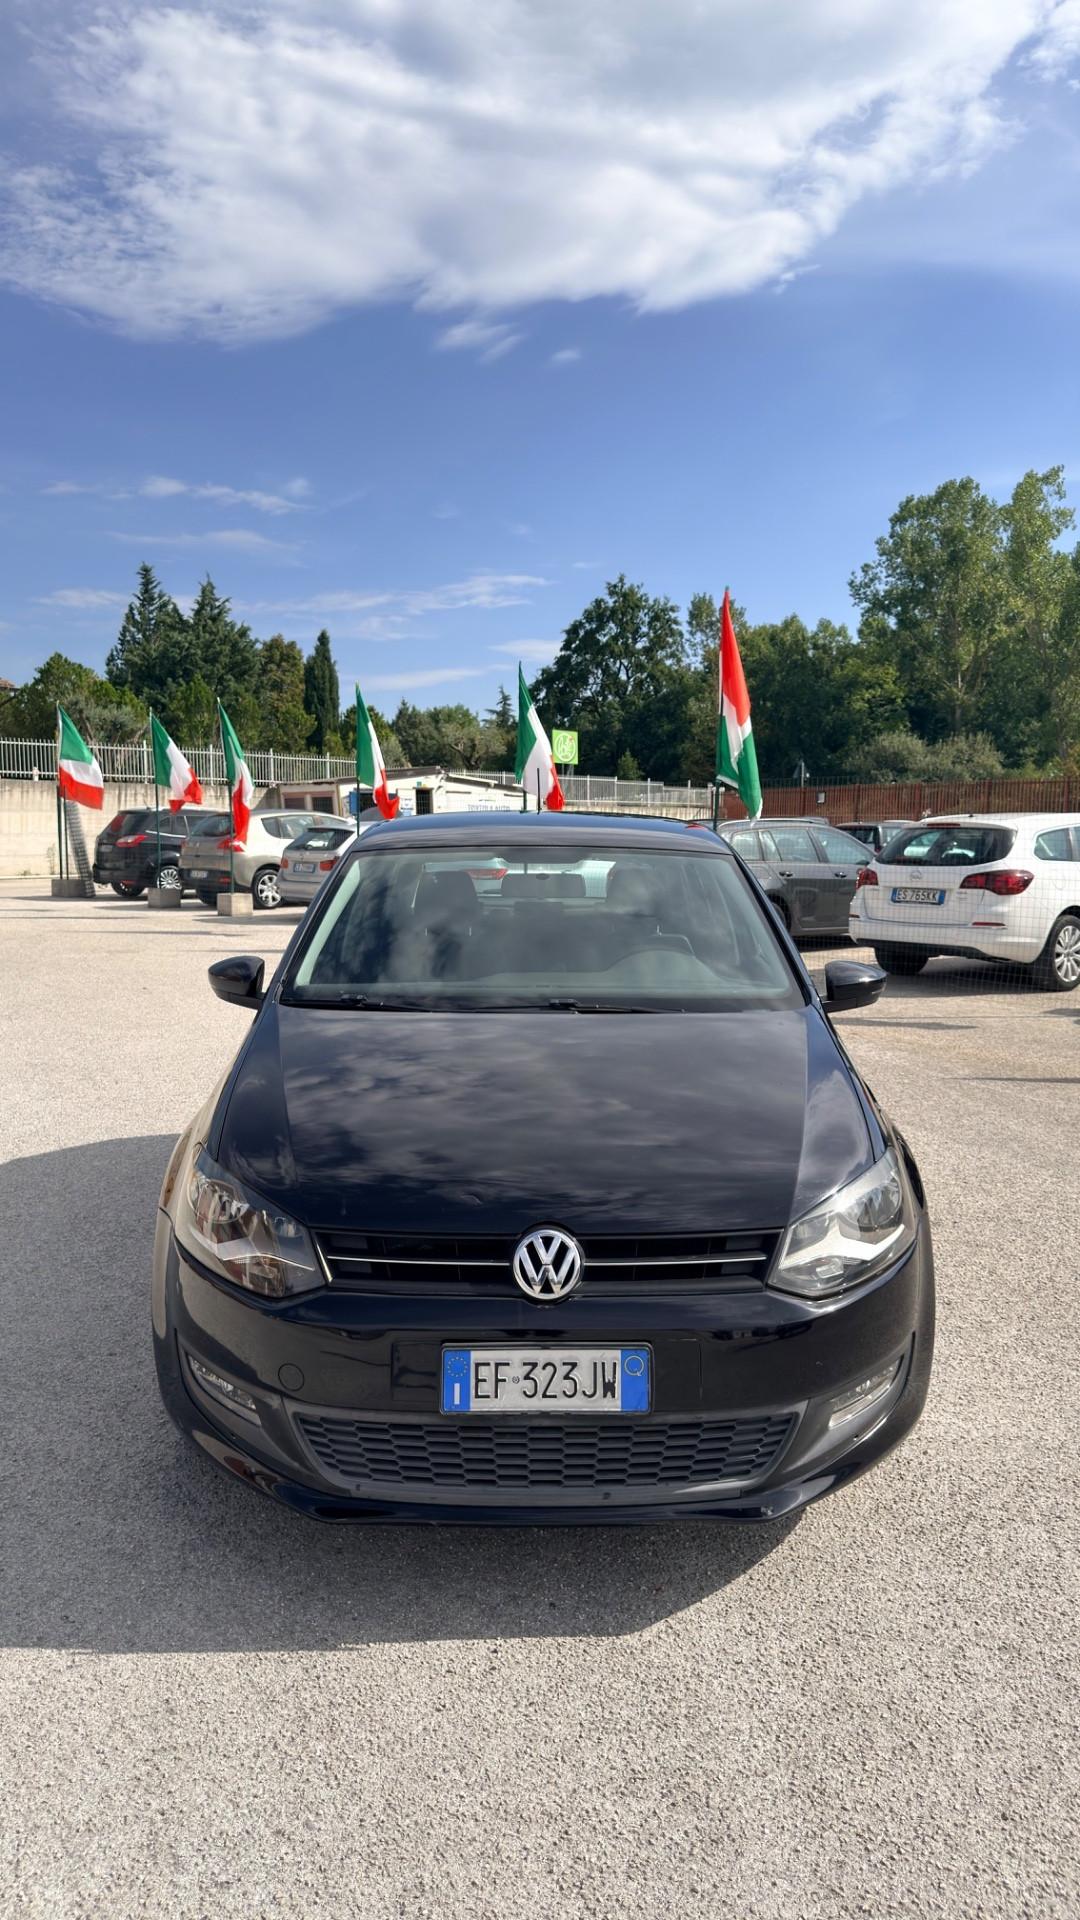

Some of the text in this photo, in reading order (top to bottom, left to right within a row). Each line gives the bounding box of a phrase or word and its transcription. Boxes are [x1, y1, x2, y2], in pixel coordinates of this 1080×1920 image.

[897, 888, 938, 902] ES 765KK
[474, 1361, 618, 1400] EF 323JW
